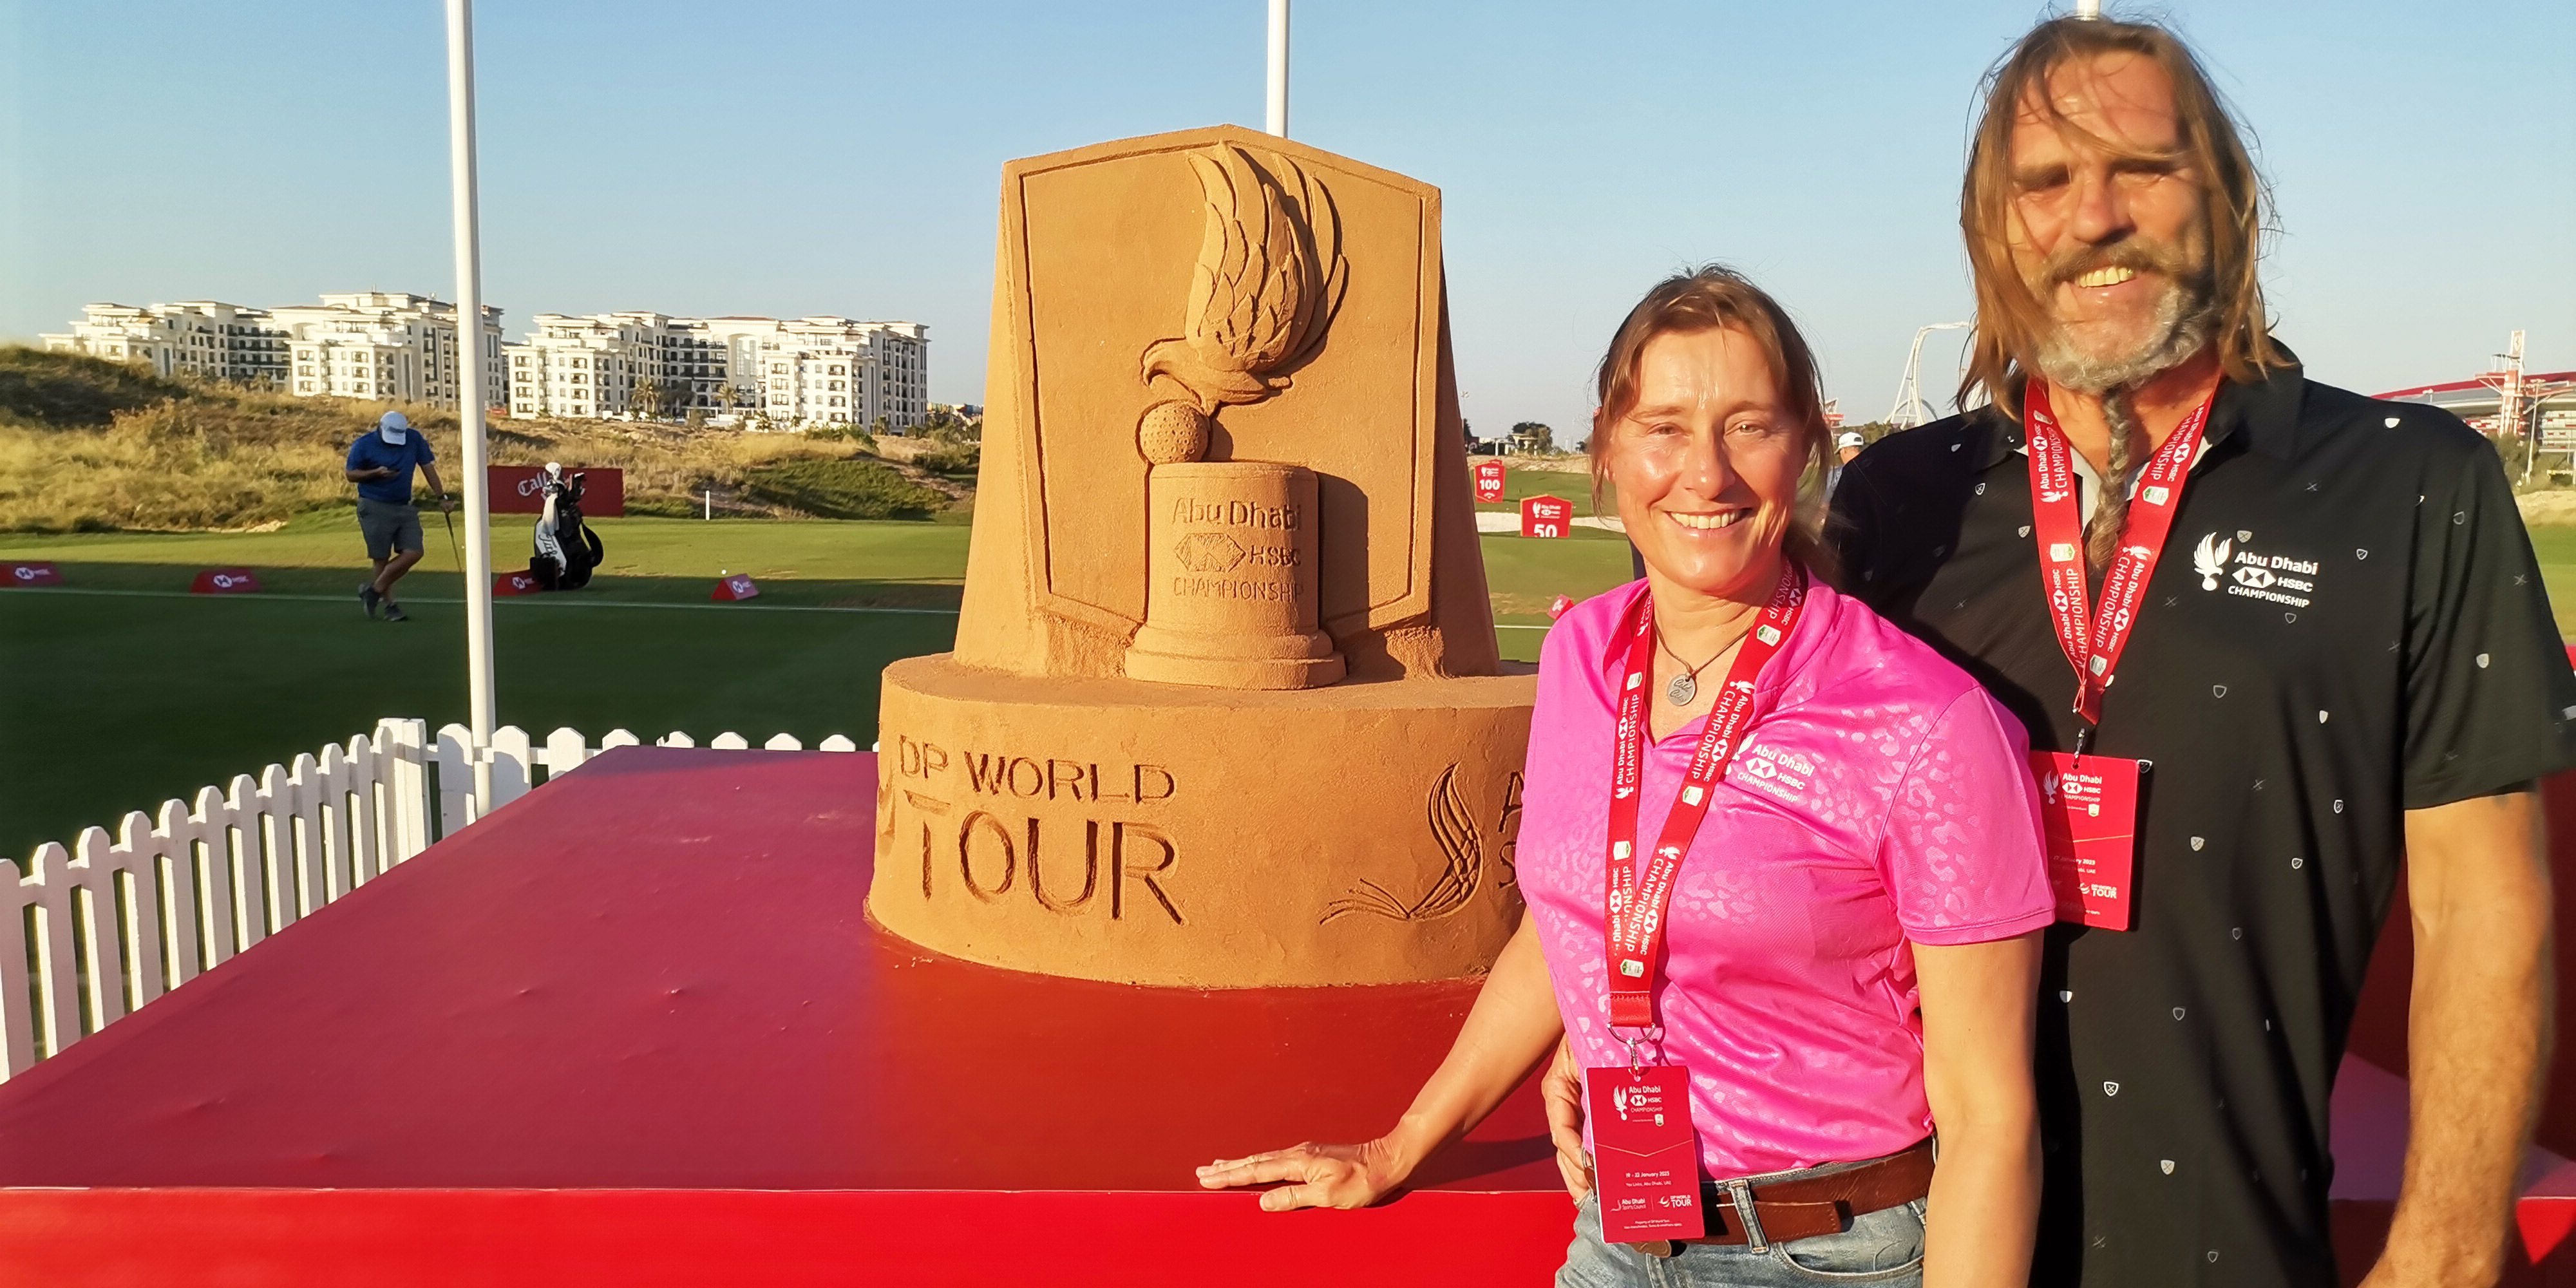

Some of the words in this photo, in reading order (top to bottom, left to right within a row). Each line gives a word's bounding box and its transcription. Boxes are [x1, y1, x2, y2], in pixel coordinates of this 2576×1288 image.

[2046, 426, 2068, 489] CHAMPIONSHIP
[2150, 413, 2193, 480] HAMPIONSHIP
[2037, 451, 2048, 473] Dhabi
[2167, 464, 2181, 482] HSBC
[1479, 479, 1501, 490] 100
[2040, 473, 2050, 489] Abu
[1171, 497, 1223, 526] Abu
[1229, 500, 1302, 531] Dhabi
[1534, 524, 1557, 537] 50
[1249, 544, 1302, 567] HSBC
[2234, 551, 2269, 567] Abu
[2271, 556, 2319, 575] Dhabi
[2052, 569, 2062, 589] HSBC
[2130, 561, 2145, 580] Abu
[1172, 576, 1303, 603] CHAMPIONSHIP
[1768, 568, 1794, 620] PIONSHIP
[2121, 579, 2139, 609] Dhabi
[2277, 577, 2313, 592] HSBC
[2096, 556, 2130, 649] CHAMPIONSHIP
[2227, 585, 2310, 608] CHAMPIONSHIP
[1781, 607, 1794, 626] HSBC
[2060, 613, 2072, 639] Dhabi
[2107, 632, 2119, 653] HSBC
[1734, 694, 1749, 713] Abu
[1692, 690, 1736, 779] CHAMPIONSHIP
[1723, 712, 1741, 741] Dhabi
[1625, 694, 1640, 784] CHAMPIONSHIP
[1618, 741, 1626, 766] Dhabi
[1752, 744, 1777, 761] Abu
[1777, 753, 1815, 777] Dhabi
[899, 734, 949, 779] DP
[963, 750, 1177, 804] WORLD
[1703, 762, 1716, 782] HSBC
[2063, 772, 2078, 782] Abu
[2079, 774, 2103, 784] Dhabi
[1737, 772, 1799, 803] CHAMPIONSHIP
[1777, 772, 1806, 791] HSBC
[903, 789, 1188, 926] TOUR
[1663, 862, 1674, 880] Abu
[1624, 858, 1664, 952] CHAMPIONSHIP
[1651, 880, 1666, 909] Dhabi
[2092, 888, 2117, 899] TOUR
[1640, 934, 1651, 956] HSBC
[1629, 1085, 1642, 1094] Abu
[1642, 1085, 1662, 1094] Dhabi
[1670, 1199, 1692, 1208] TOUR
